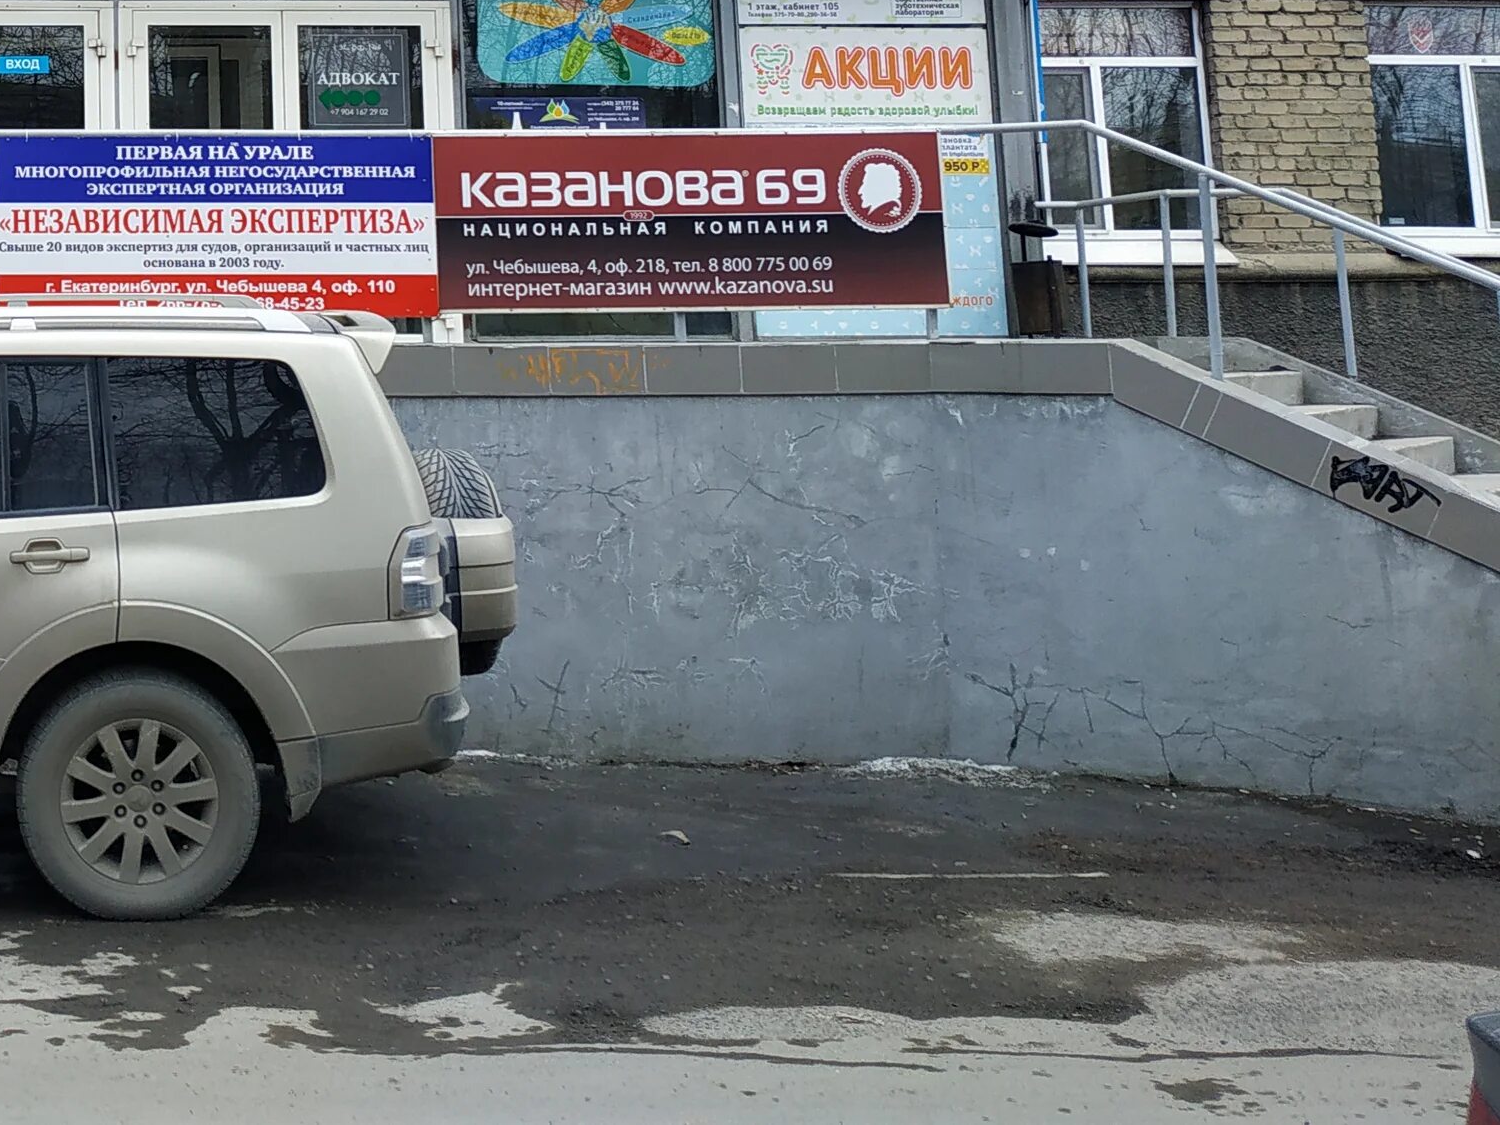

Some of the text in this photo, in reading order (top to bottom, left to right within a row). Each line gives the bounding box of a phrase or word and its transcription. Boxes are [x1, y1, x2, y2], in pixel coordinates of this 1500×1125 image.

[756, 3, 780, 11] этаж,
[783, 2, 819, 10] кабинет
[823, 2, 840, 10] 105
[5, 59, 41, 72] ВХОД
[802, 46, 973, 97] АКЦИИ
[317, 71, 400, 87] АДВОКАТ
[756, 104, 979, 117] Возвращаем радость здоровой улыбки!
[116, 145, 314, 160] ПЕРВАЯ НА УРАЛЕ
[14, 165, 416, 179] МНОГОПРОФИЛЬНАЯ НЕГОСУДАРСТВЕННАЯ
[944, 161, 968, 172] 950
[86, 182, 344, 197] ЭКСПЕРТНАЯ ОРГАНИЗАЦИЯ
[756, 169, 827, 205] 69
[0, 208, 425, 234] «НЕЗАВИСИМАЯ ЭКСПЕРТИЗА»
[463, 220, 828, 238] НАЦИОНАЛЬНАЯ КОМПАНИЯ
[47, 242, 62, 252] 20
[65, 243, 104, 253] видов
[107, 244, 173, 254] экспертиз
[175, 244, 198, 253] для
[201, 244, 241, 254] судов,
[244, 241, 331, 254] организаций
[334, 244, 343, 252] и
[346, 244, 401, 252] частных
[403, 244, 429, 254] лиц
[143, 257, 285, 270] основана в 2003 году.
[466, 256, 833, 278] ул. Чебышева, 4, оф. 218, тел. 8 800 775 00 69
[45, 279, 395, 296] г. Екатеринбург, ул. Чебышева 4, оф. 110
[468, 276, 834, 301] интернет-магазин www.kazanova.su
